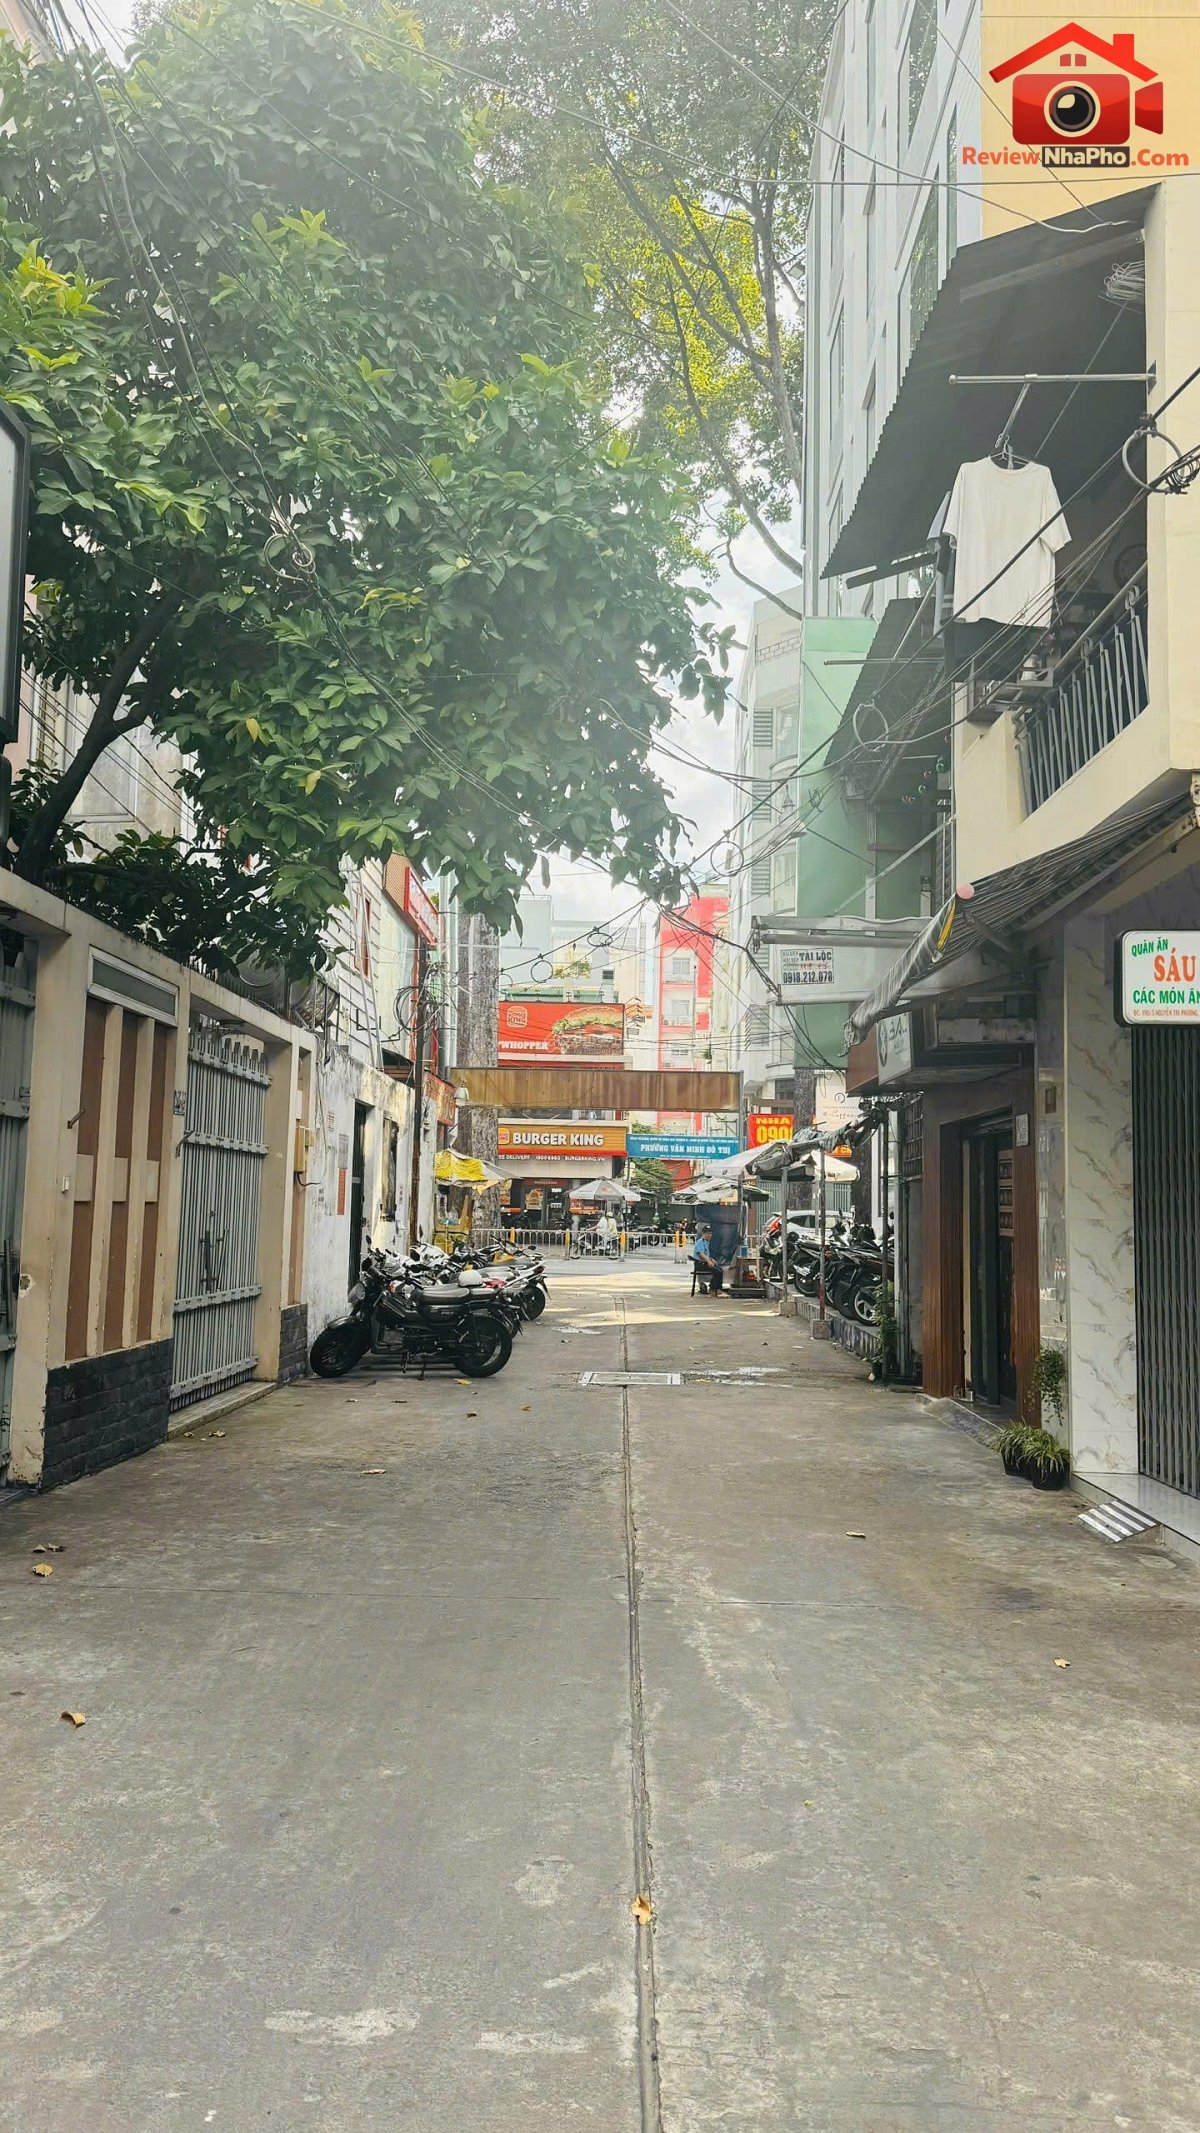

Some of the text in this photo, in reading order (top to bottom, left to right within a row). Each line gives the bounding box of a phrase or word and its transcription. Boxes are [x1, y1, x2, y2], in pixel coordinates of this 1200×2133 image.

[1131, 936, 1168, 957] QUÁN ĂN
[1154, 947, 1196, 982] SÁU
[1133, 986, 1155, 1004] CÁC
[1160, 986, 1184, 1004] MÓN
[512, 1132, 604, 1146] BURGER KING
